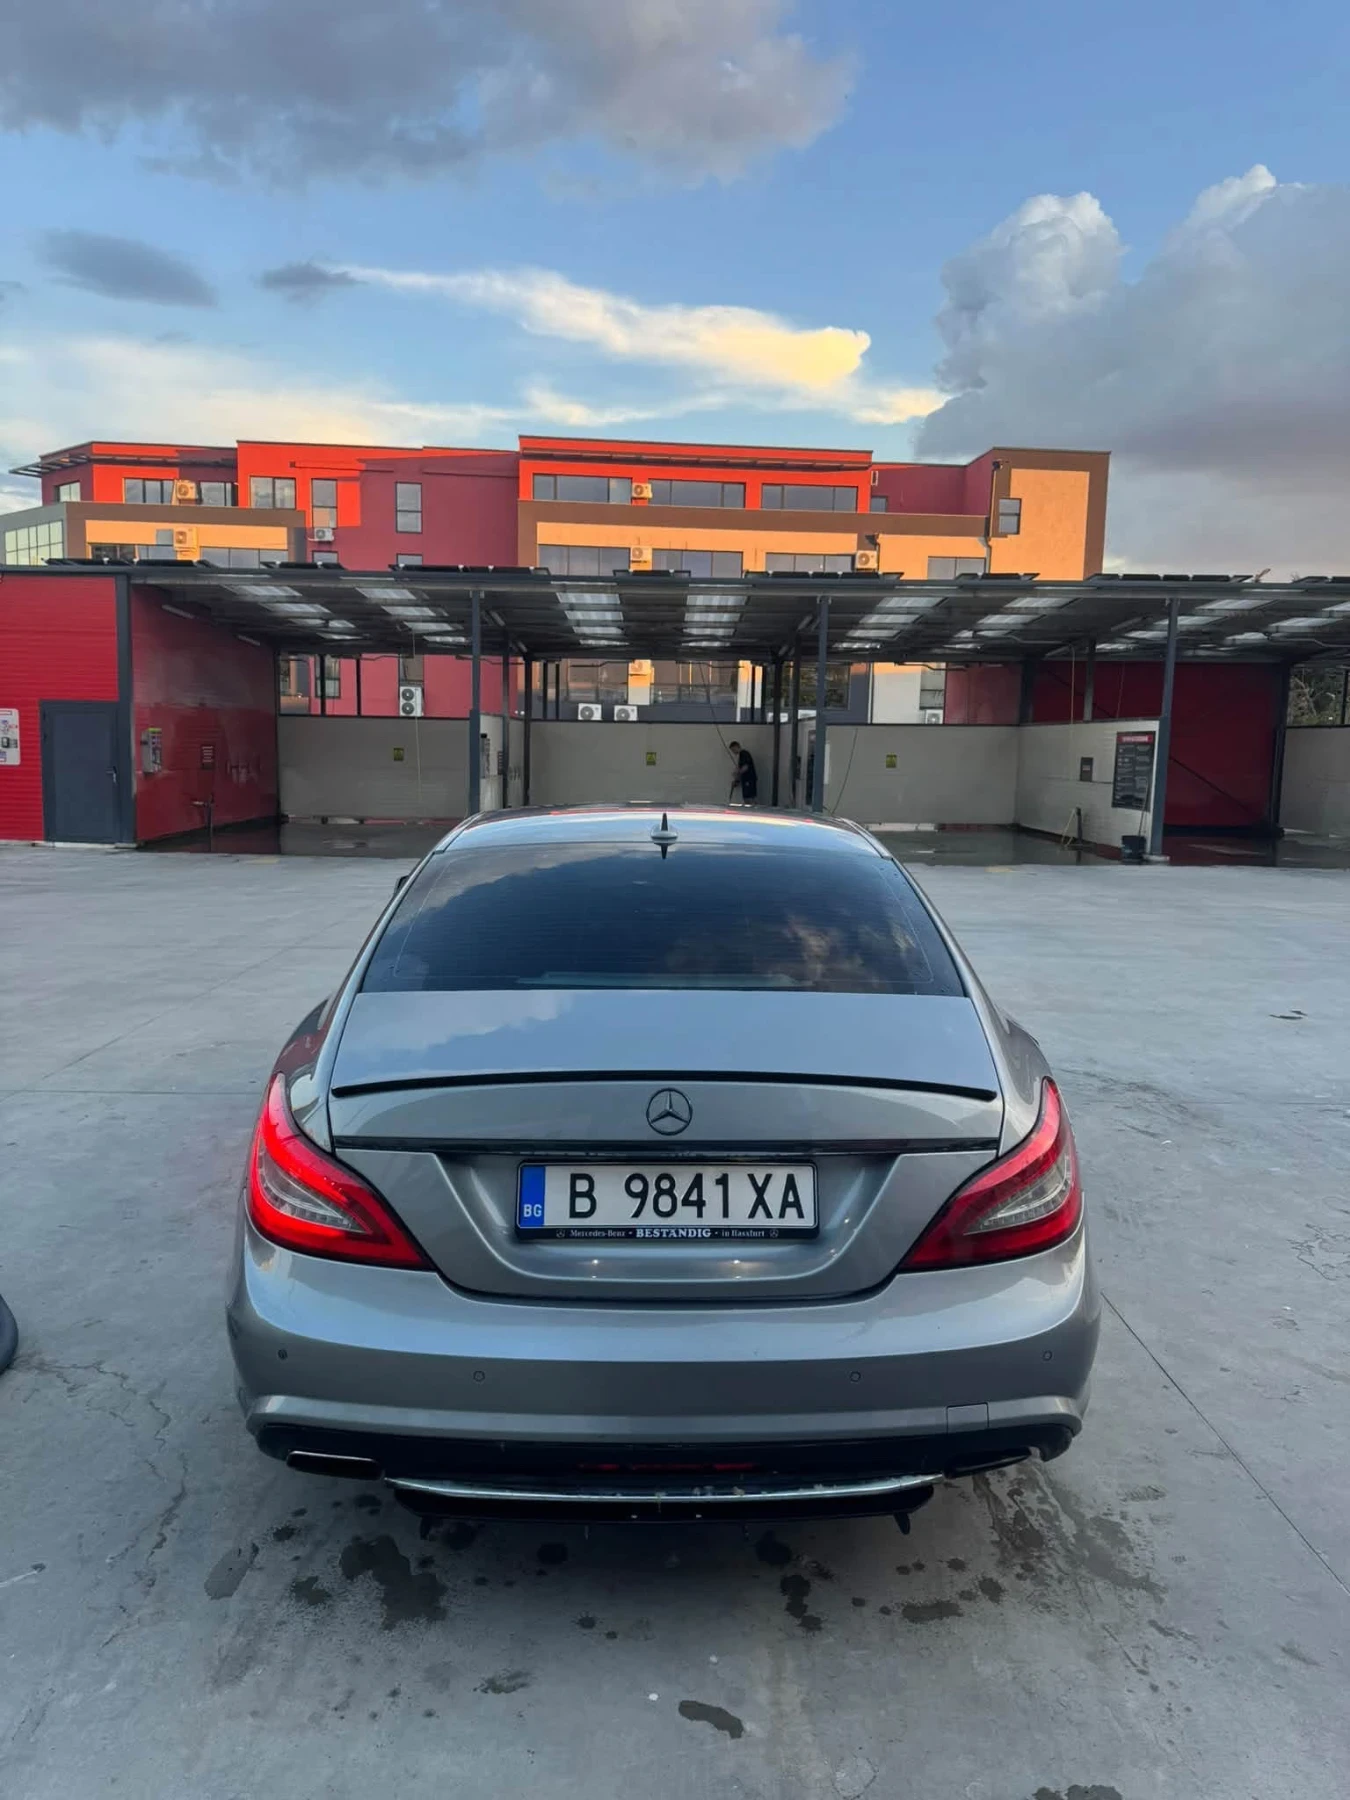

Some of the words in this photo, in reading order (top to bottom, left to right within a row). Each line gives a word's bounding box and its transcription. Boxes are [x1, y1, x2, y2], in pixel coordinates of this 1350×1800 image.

[569, 1173, 597, 1218] B
[624, 1173, 730, 1218] 9841
[747, 1173, 804, 1218] XA
[522, 1204, 542, 1218] BG
